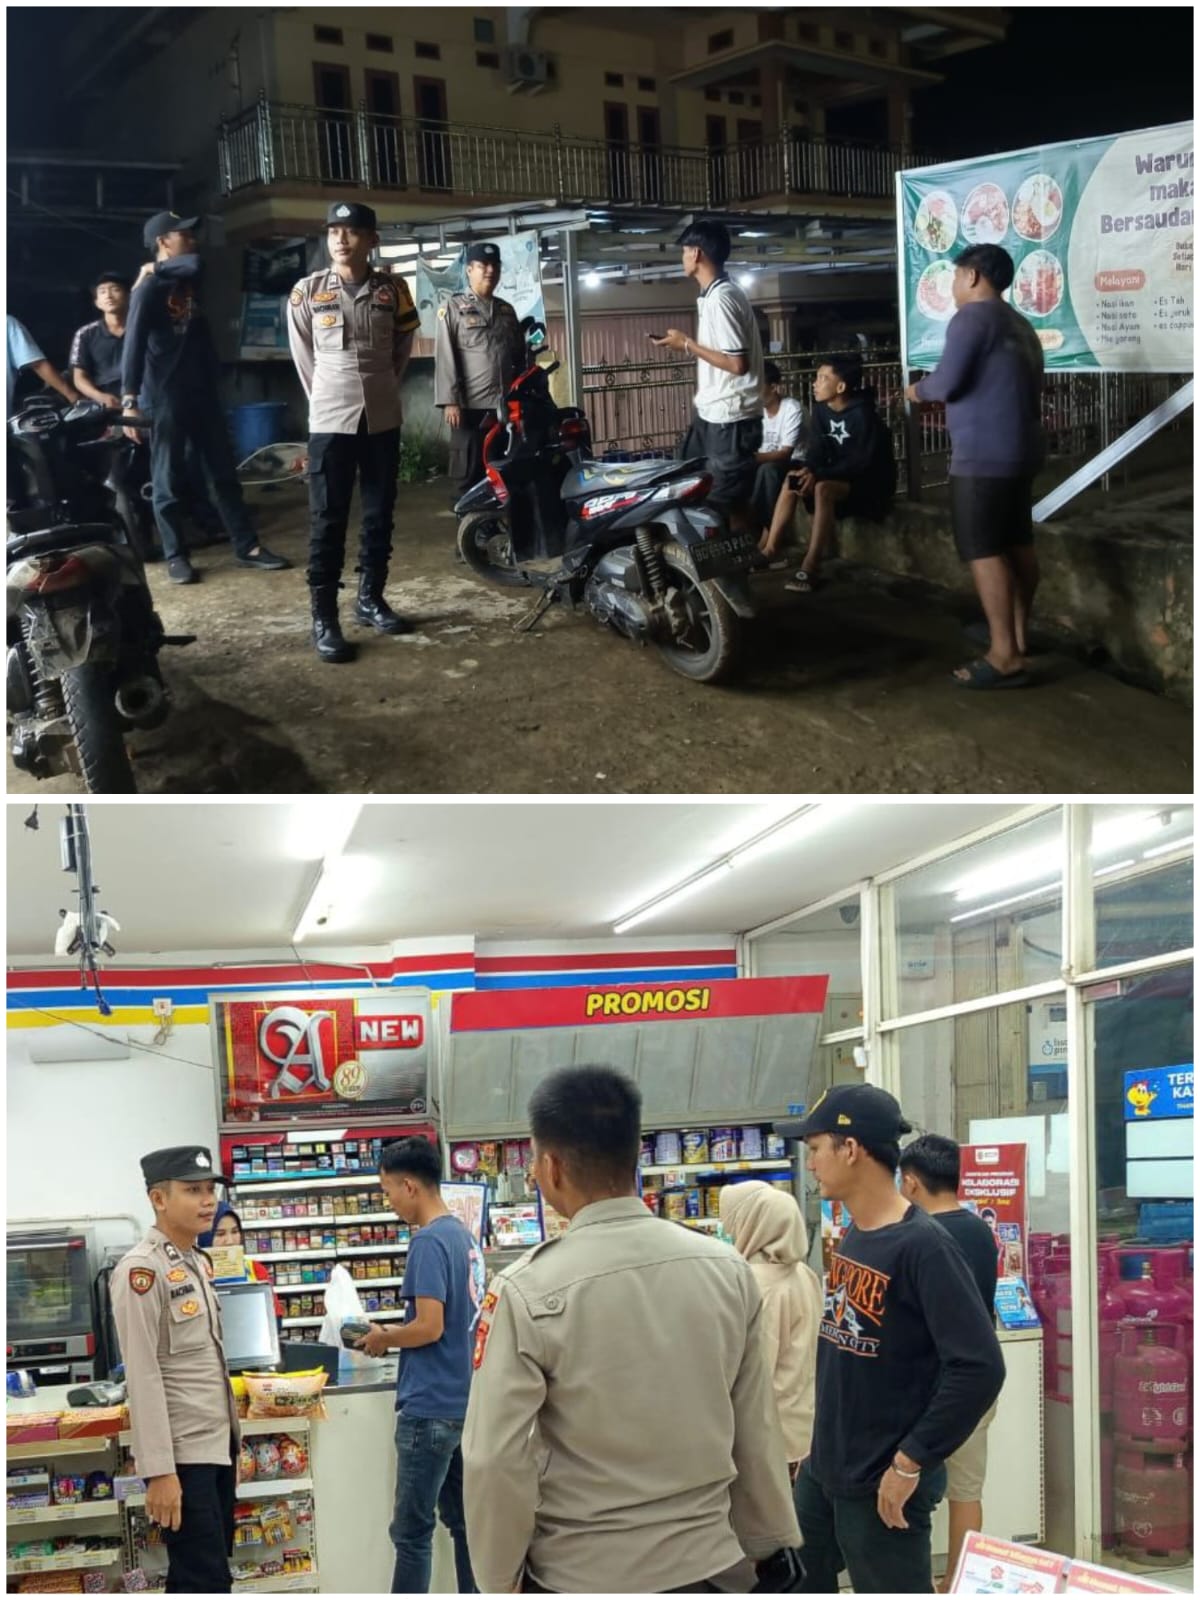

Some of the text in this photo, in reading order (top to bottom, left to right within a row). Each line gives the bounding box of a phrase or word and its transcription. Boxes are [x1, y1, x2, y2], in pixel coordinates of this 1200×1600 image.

[1101, 206, 1194, 234] Bersauda
[586, 988, 710, 1016] PROMOSI
[360, 1019, 419, 1042] NEW
[341, 1065, 361, 1087] 89
